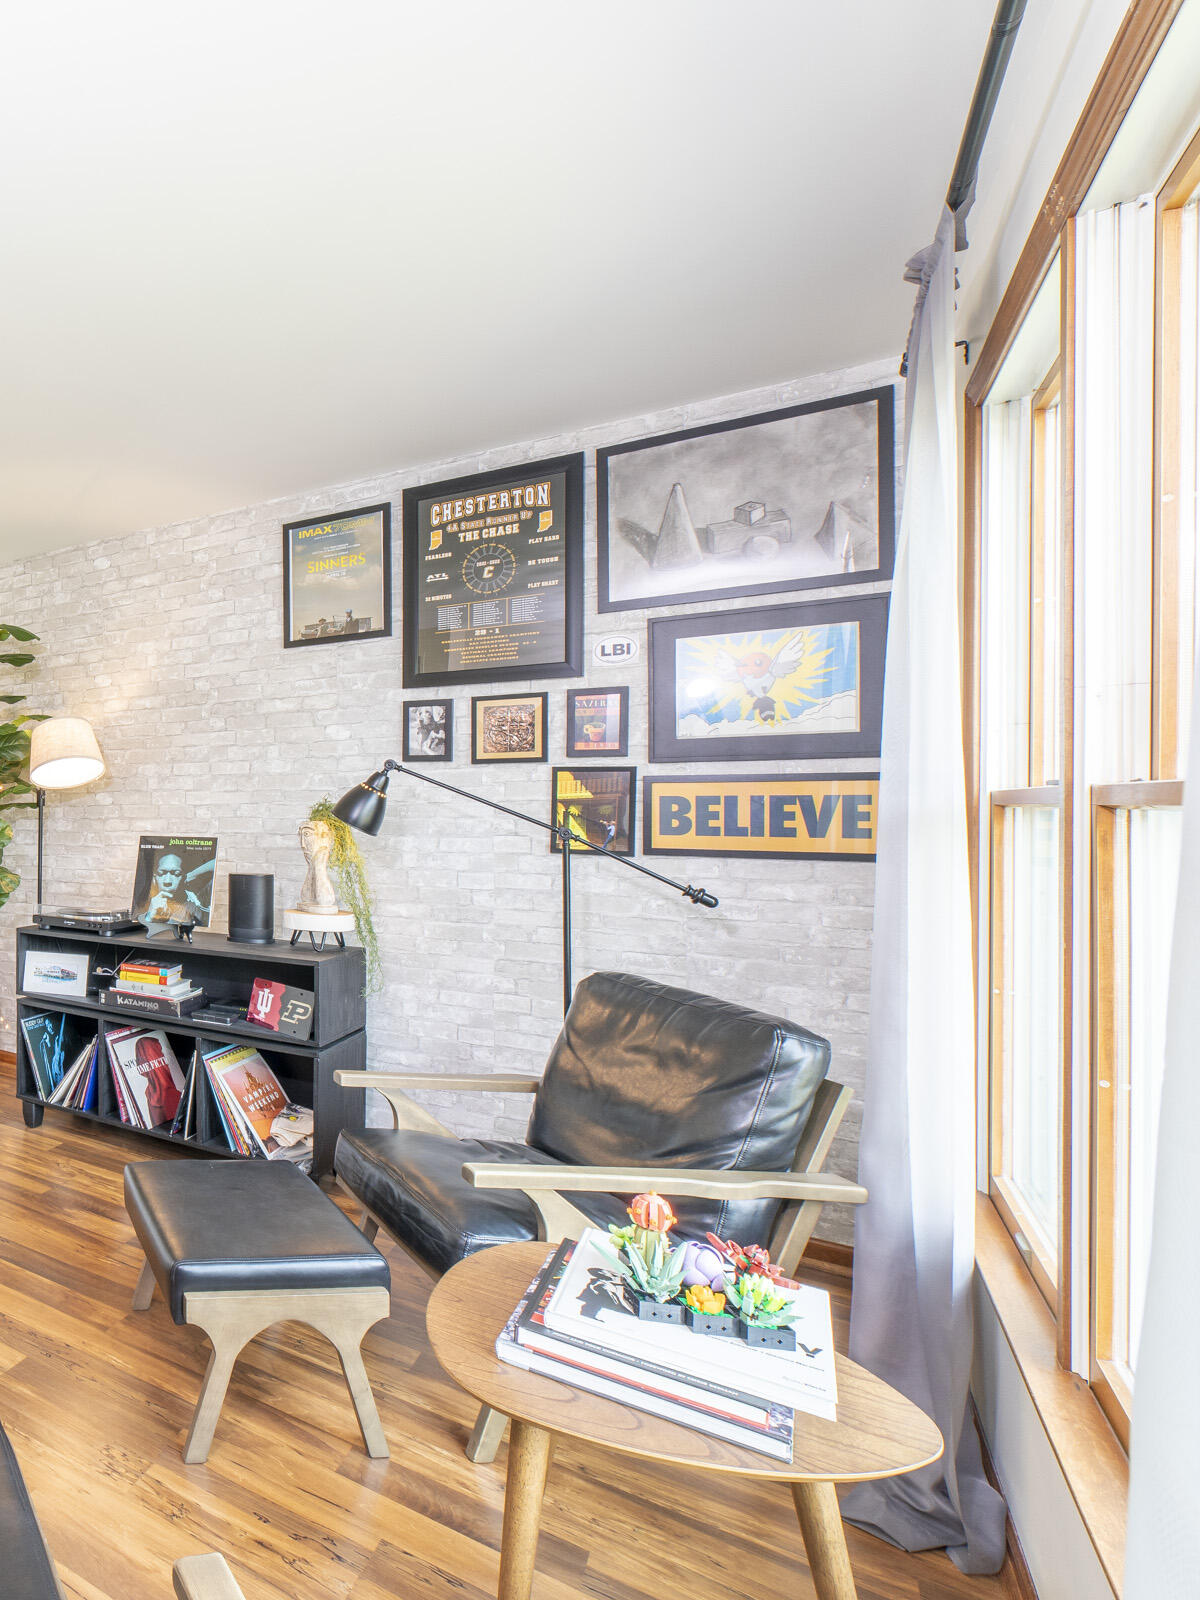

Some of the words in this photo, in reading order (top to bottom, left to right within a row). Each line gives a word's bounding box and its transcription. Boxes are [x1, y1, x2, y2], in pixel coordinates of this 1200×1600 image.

[431, 482, 551, 527] CHESTERTON
[298, 525, 332, 539] IMAX
[458, 531, 480, 542] THE
[482, 523, 519, 539] CHASE
[307, 552, 366, 573] SINNERS
[483, 566, 495, 578] C
[600, 643, 630, 656] LBI
[659, 794, 873, 839] BELIEVE
[117, 995, 159, 1009] KATAMINO
[242, 1082, 275, 1103] VAMPIRE
[248, 1091, 279, 1112] WEEKEND
